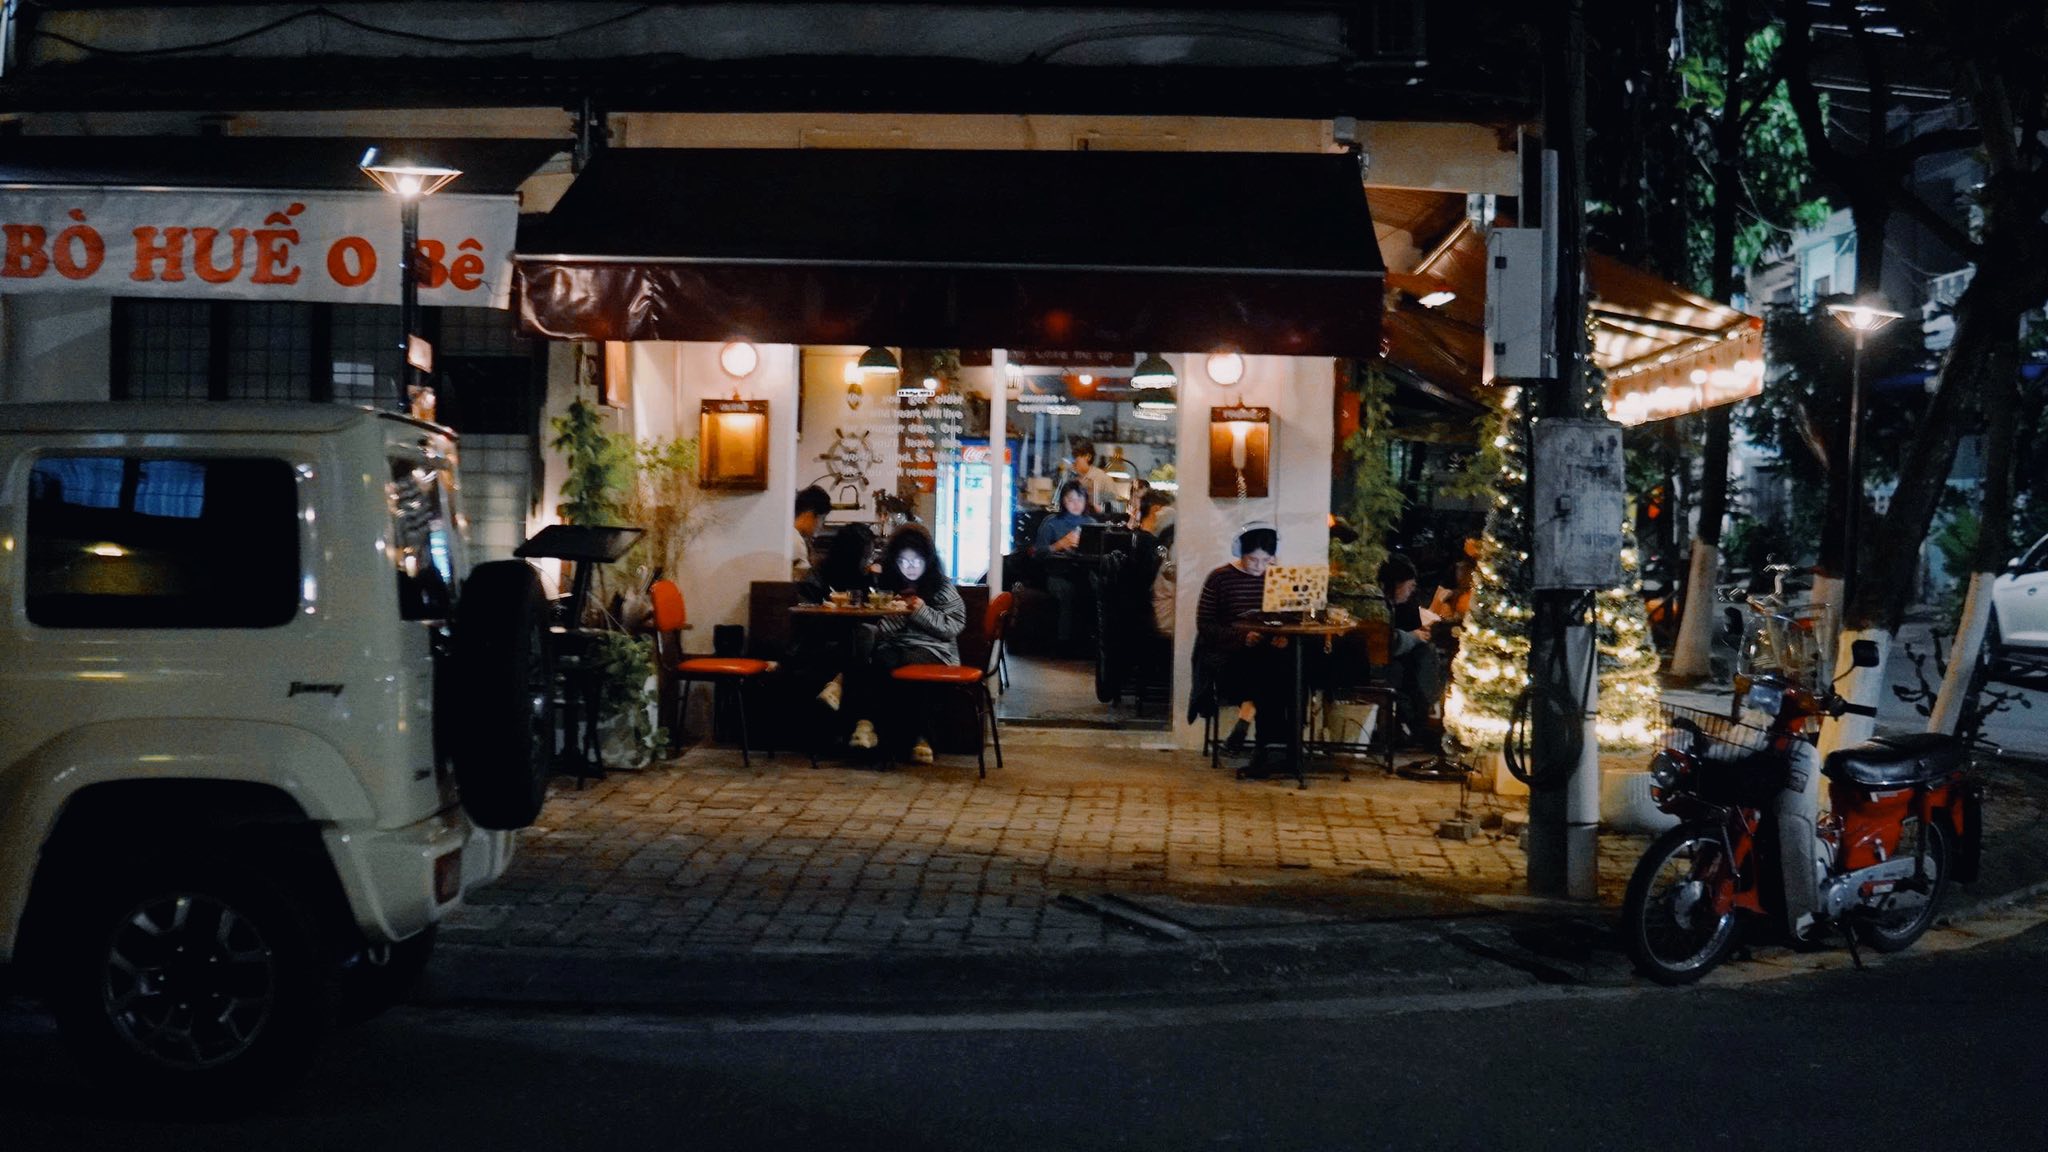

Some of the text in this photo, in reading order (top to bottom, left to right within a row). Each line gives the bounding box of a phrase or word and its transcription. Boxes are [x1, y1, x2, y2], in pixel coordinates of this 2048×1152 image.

[2, 208, 105, 281] BÒ
[129, 202, 306, 284] HUẾ
[907, 396, 928, 407] get
[935, 394, 964, 405] older
[894, 408, 921, 419] heart
[921, 408, 942, 419] will
[904, 437, 935, 449] leave
